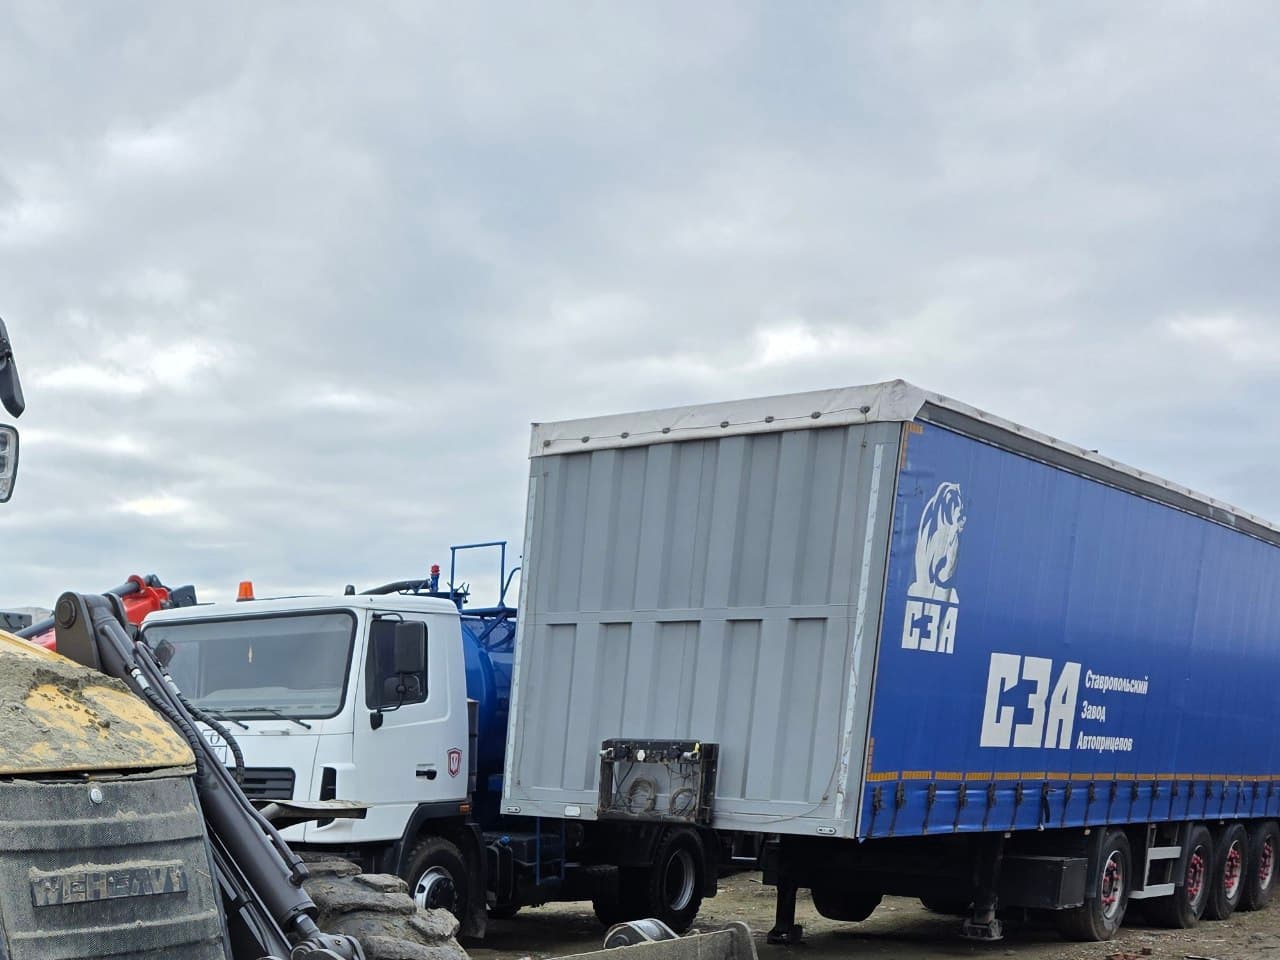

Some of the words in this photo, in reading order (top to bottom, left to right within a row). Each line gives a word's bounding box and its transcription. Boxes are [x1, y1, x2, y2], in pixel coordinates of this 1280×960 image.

[901, 600, 959, 654] СЗА
[1085, 669, 1149, 694] Ставропольский
[979, 652, 1082, 749] СЗА
[1081, 700, 1106, 723] Завод
[1077, 731, 1133, 753] Автоприцепов
